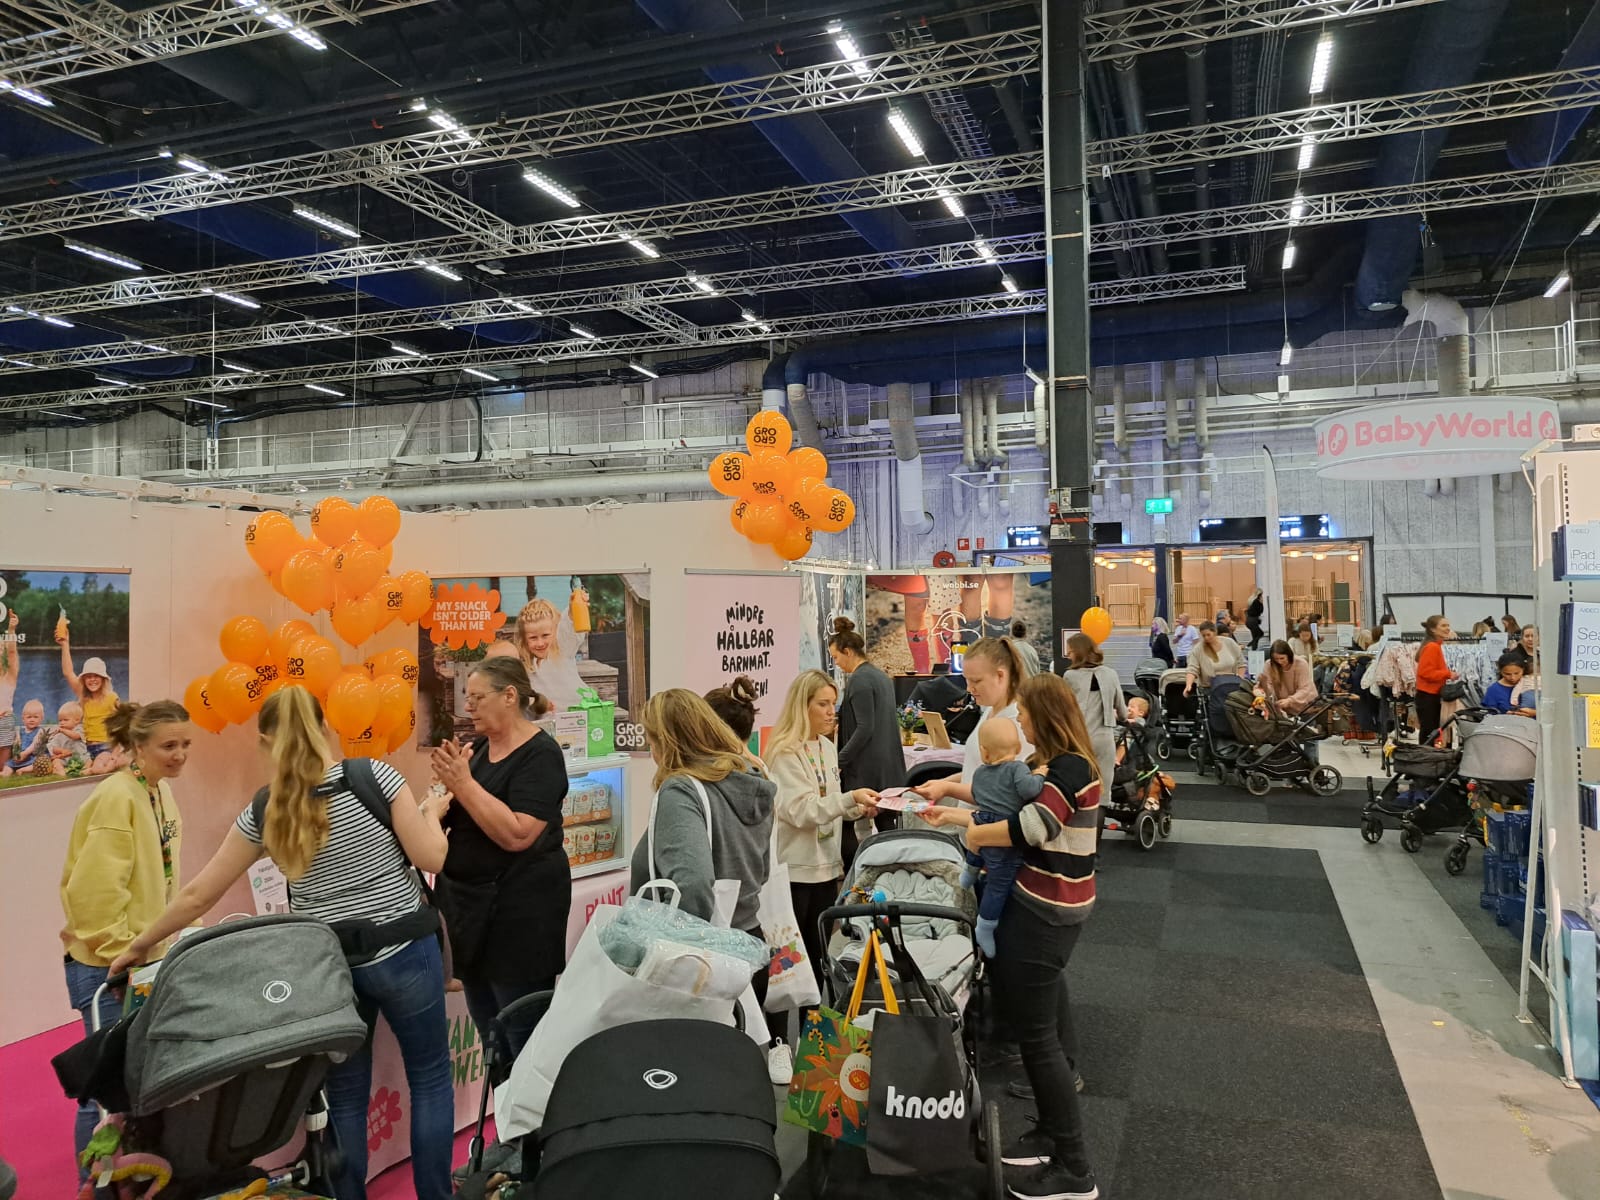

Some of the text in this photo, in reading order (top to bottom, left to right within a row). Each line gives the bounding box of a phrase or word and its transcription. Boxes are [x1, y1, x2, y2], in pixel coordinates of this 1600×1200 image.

[754, 427, 777, 435] GRO
[1355, 410, 1532, 447] BabyWorld
[1570, 549, 1595, 560] iPad
[436, 601, 488, 611] MY SNACK
[433, 611, 491, 621] ISN'T OLDER
[440, 621, 485, 631] THAN ME
[717, 625, 774, 651] HÅLLBAR
[722, 651, 771, 673] BARNMAT.
[1575, 659, 1600, 671] pre
[616, 723, 645, 735] GRO
[886, 1085, 965, 1120] knodd
